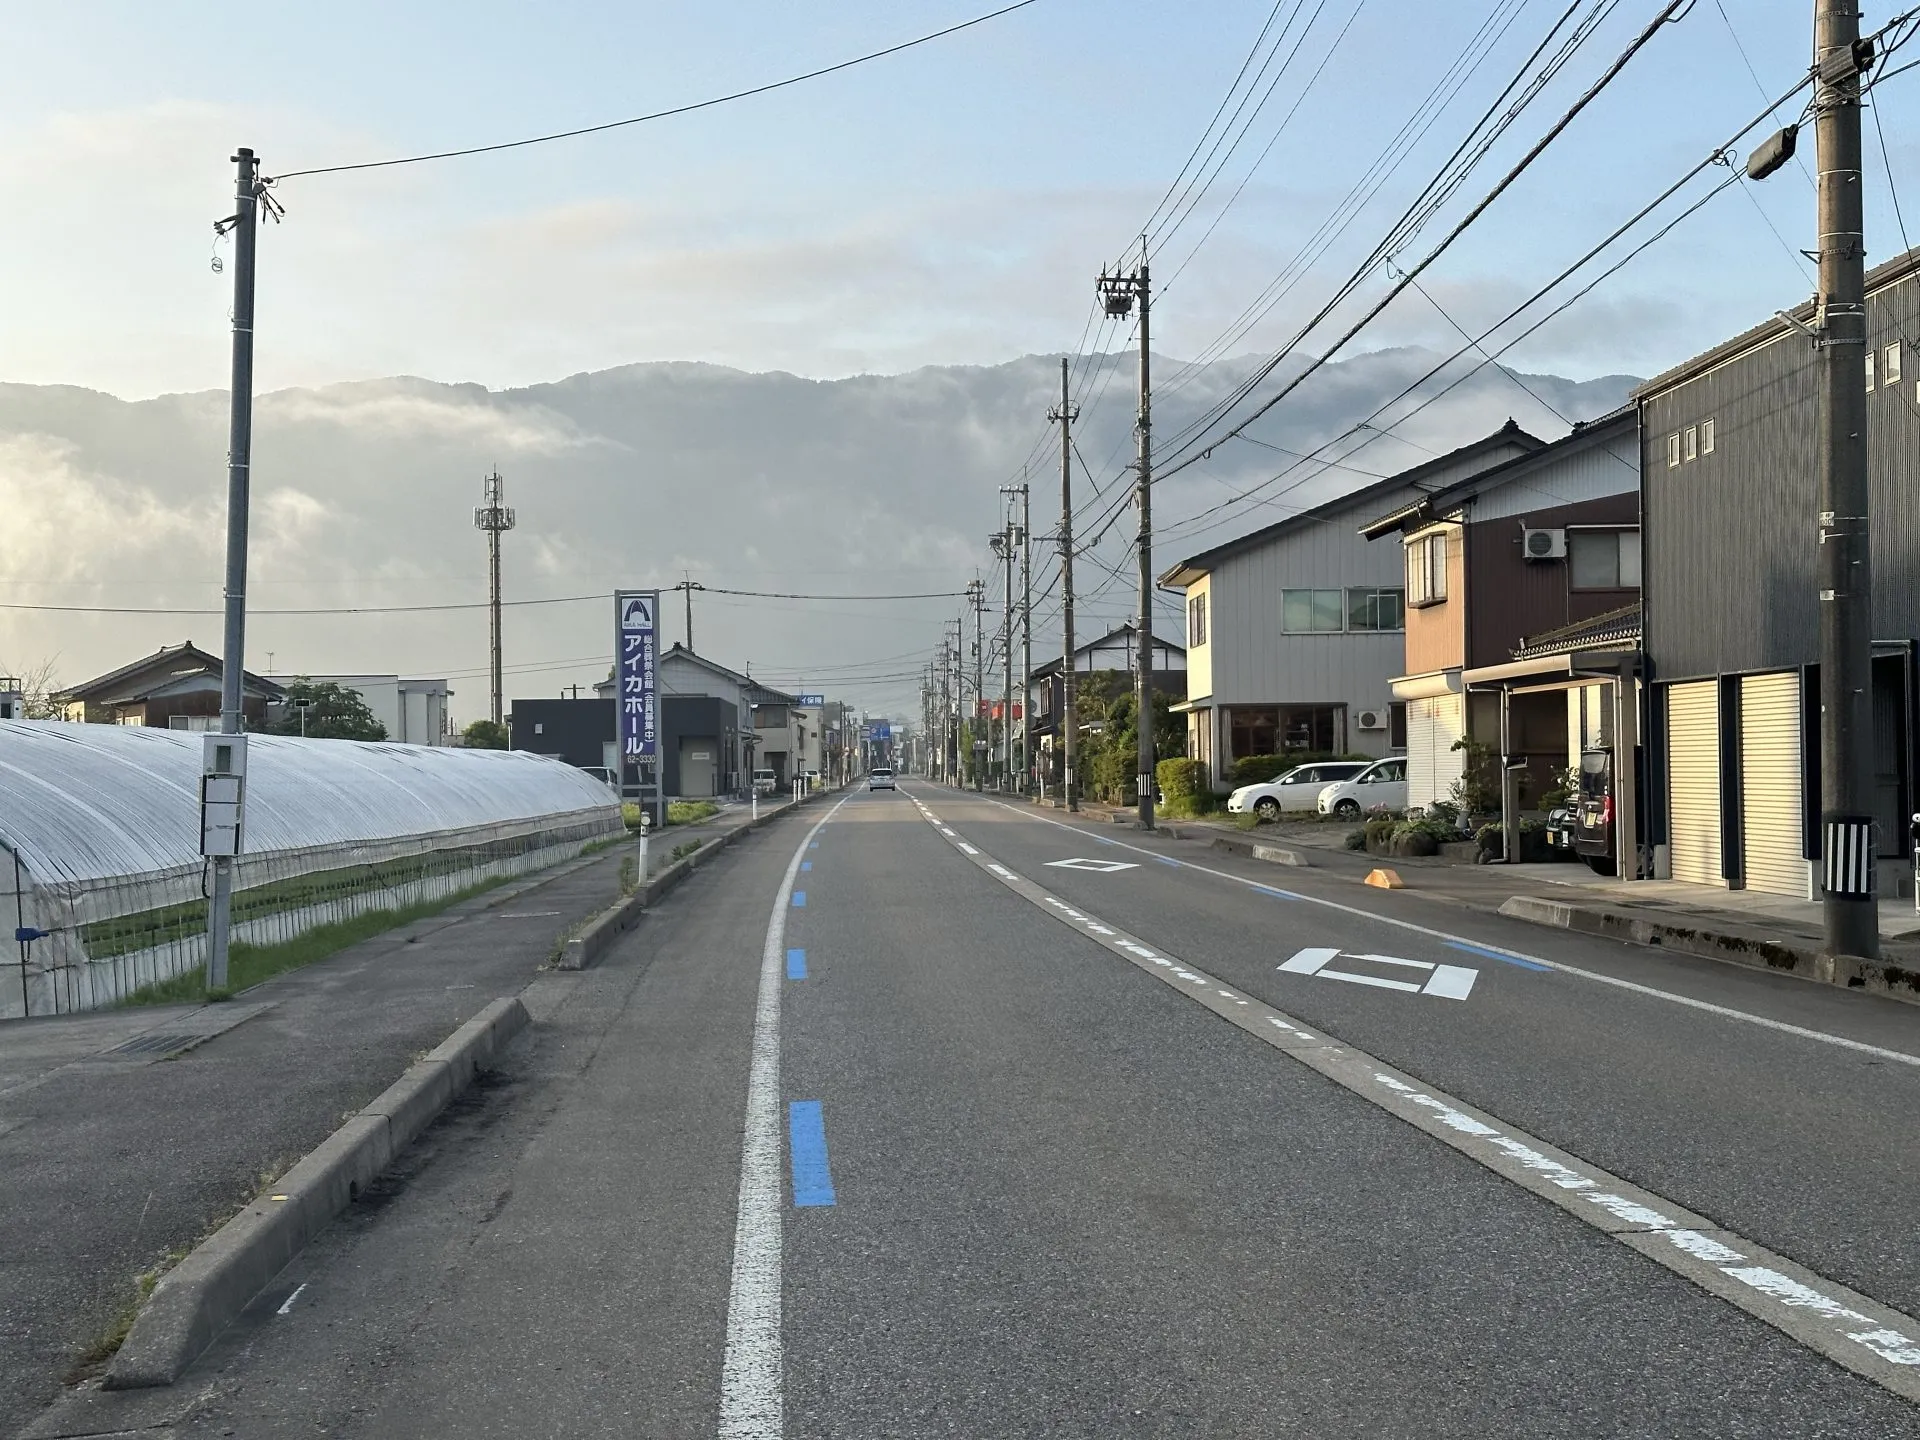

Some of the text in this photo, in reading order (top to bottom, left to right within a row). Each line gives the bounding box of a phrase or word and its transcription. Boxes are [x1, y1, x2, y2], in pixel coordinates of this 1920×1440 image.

[624, 635, 643, 754] アイカホール
[627, 754, 656, 763] 62-3330
